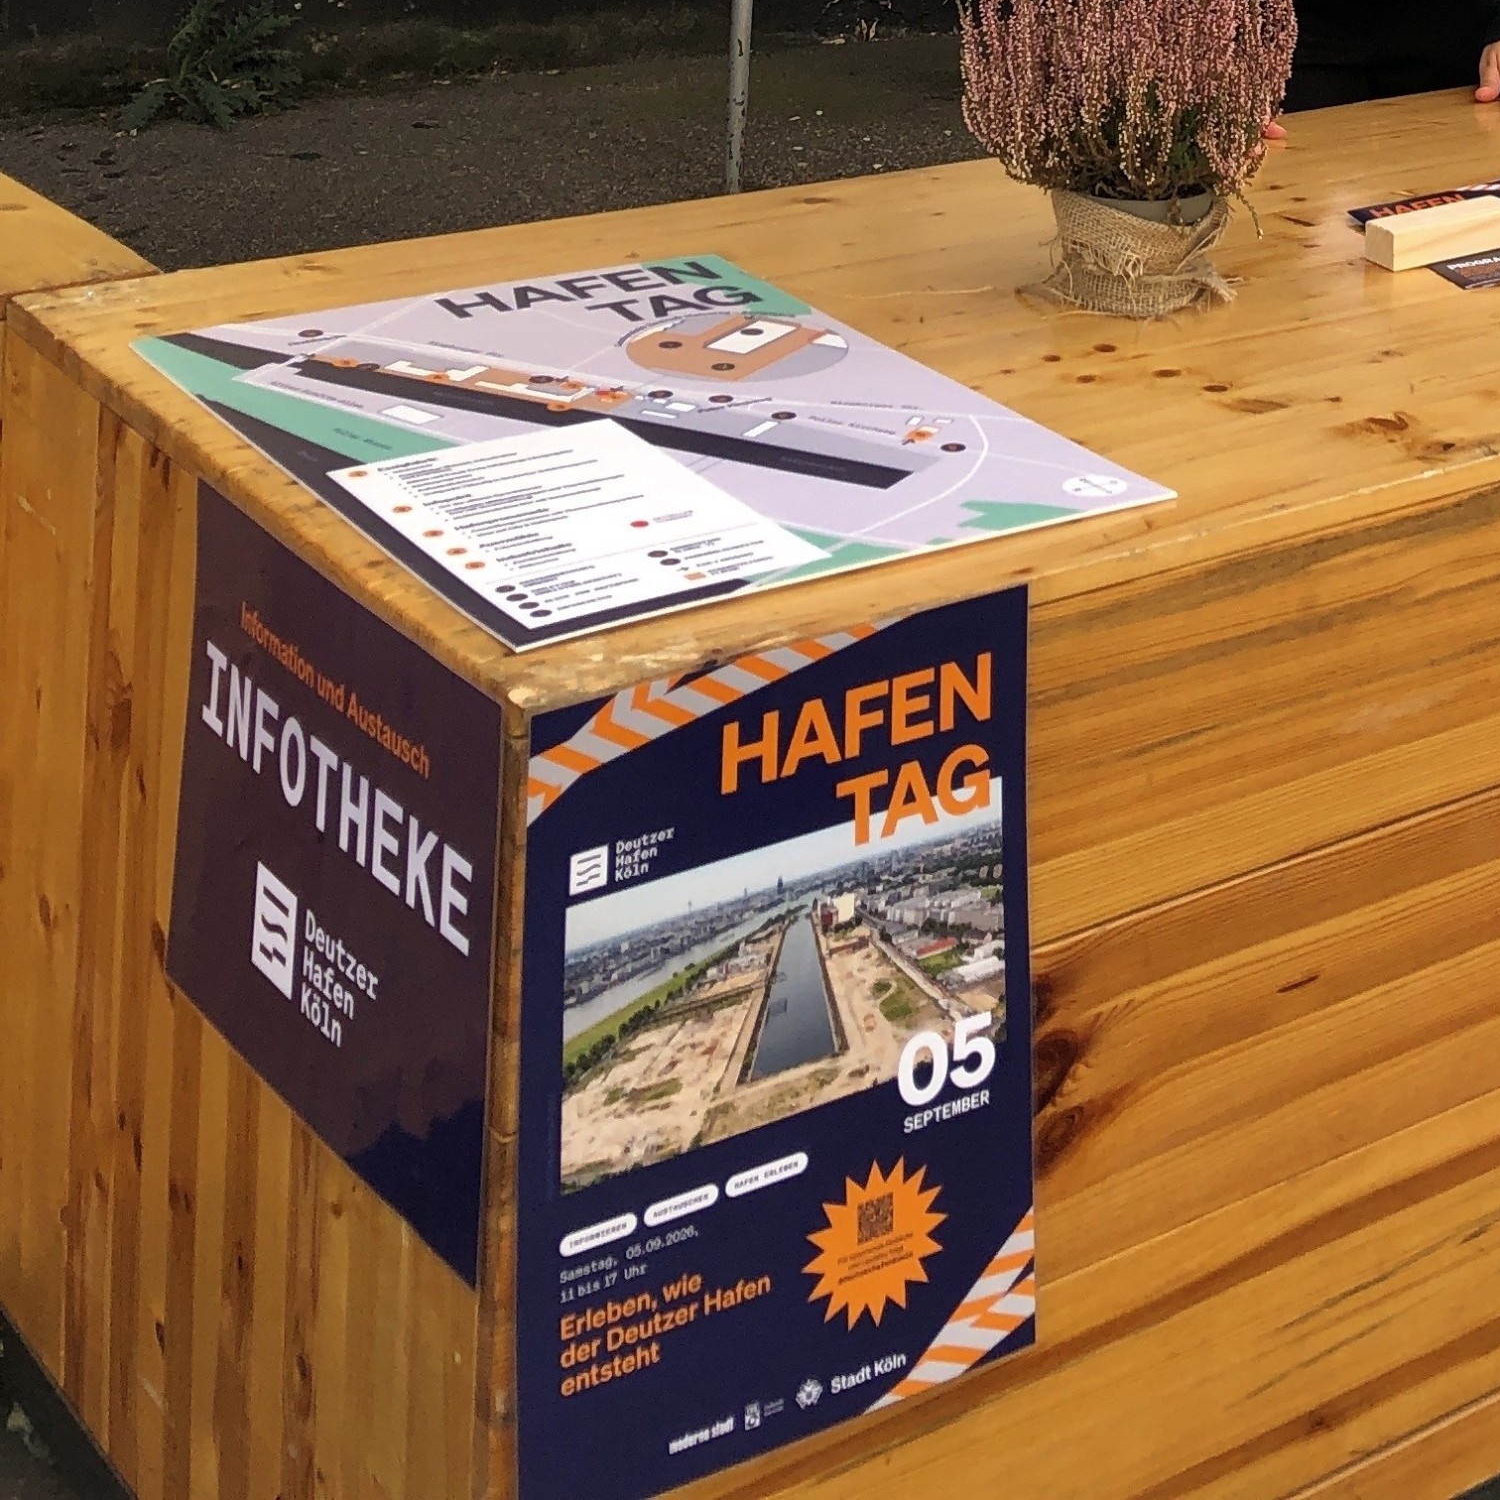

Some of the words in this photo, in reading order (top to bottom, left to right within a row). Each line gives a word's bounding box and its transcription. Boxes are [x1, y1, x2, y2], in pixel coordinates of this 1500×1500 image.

[434, 261, 723, 318] HAFEN
[585, 285, 764, 322] TAG
[240, 601, 314, 684] Information
[316, 676, 344, 714] und
[346, 691, 431, 781] Austausch
[720, 652, 992, 795] HAFEN
[202, 640, 473, 958] INFOTHEKE
[836, 744, 991, 847] TAG
[615, 827, 675, 854] Deutzer
[615, 846, 658, 868] Hafen
[614, 862, 649, 882] Köln
[302, 945, 355, 1020] Hafen
[305, 908, 378, 1001] Deutzer
[300, 983, 342, 1048] Köln
[898, 1012, 997, 1108] 05
[903, 1089, 990, 1134] SEPTEMBER
[734, 1174, 760, 1190] HAFEN
[763, 1160, 799, 1181] ERLEBEN
[560, 1256, 618, 1284] Samstag,
[625, 1225, 699, 1260] 05.09.2026,
[578, 1281, 600, 1298] bis
[604, 1272, 618, 1289] 17
[624, 1264, 649, 1281] Uhr
[560, 1292, 658, 1341] Erleben,
[662, 1272, 703, 1303] wie
[560, 1339, 601, 1369] der
[606, 1302, 699, 1352] Deutzer
[704, 1274, 772, 1317] Hafen
[560, 1341, 661, 1398] entsteht
[830, 1366, 872, 1395] Stadt
[874, 1352, 907, 1378] Köln
